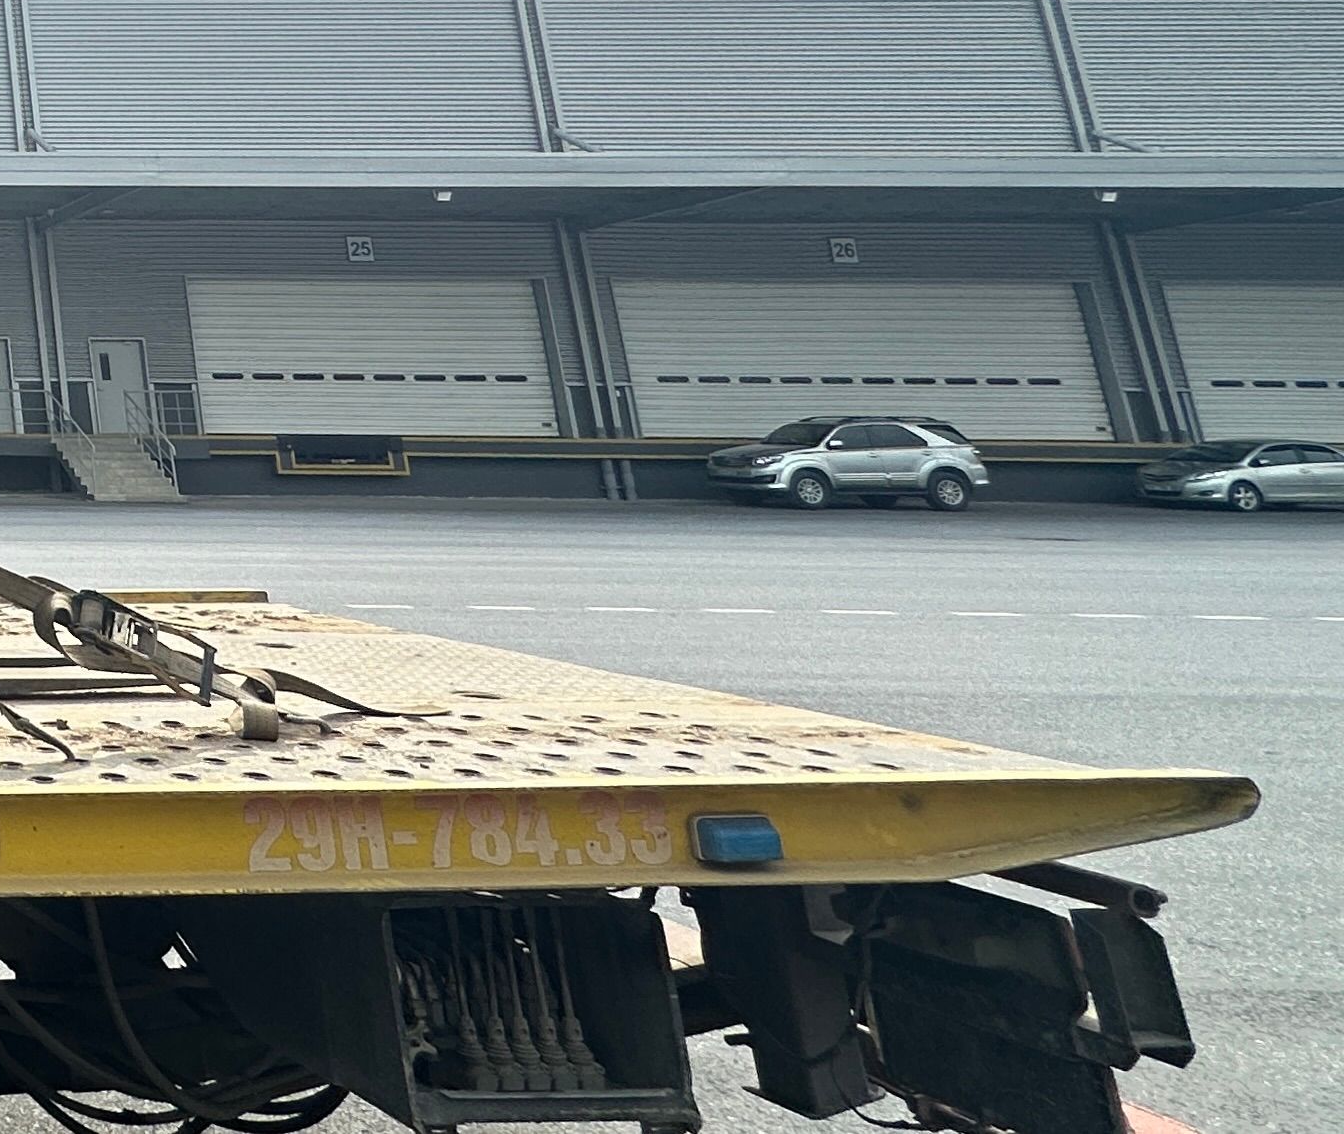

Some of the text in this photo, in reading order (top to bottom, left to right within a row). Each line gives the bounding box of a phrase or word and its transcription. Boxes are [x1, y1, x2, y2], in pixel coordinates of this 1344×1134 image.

[350, 241, 371, 256] 25
[833, 242, 855, 258] 26
[242, 789, 673, 873] 29H-784.33
